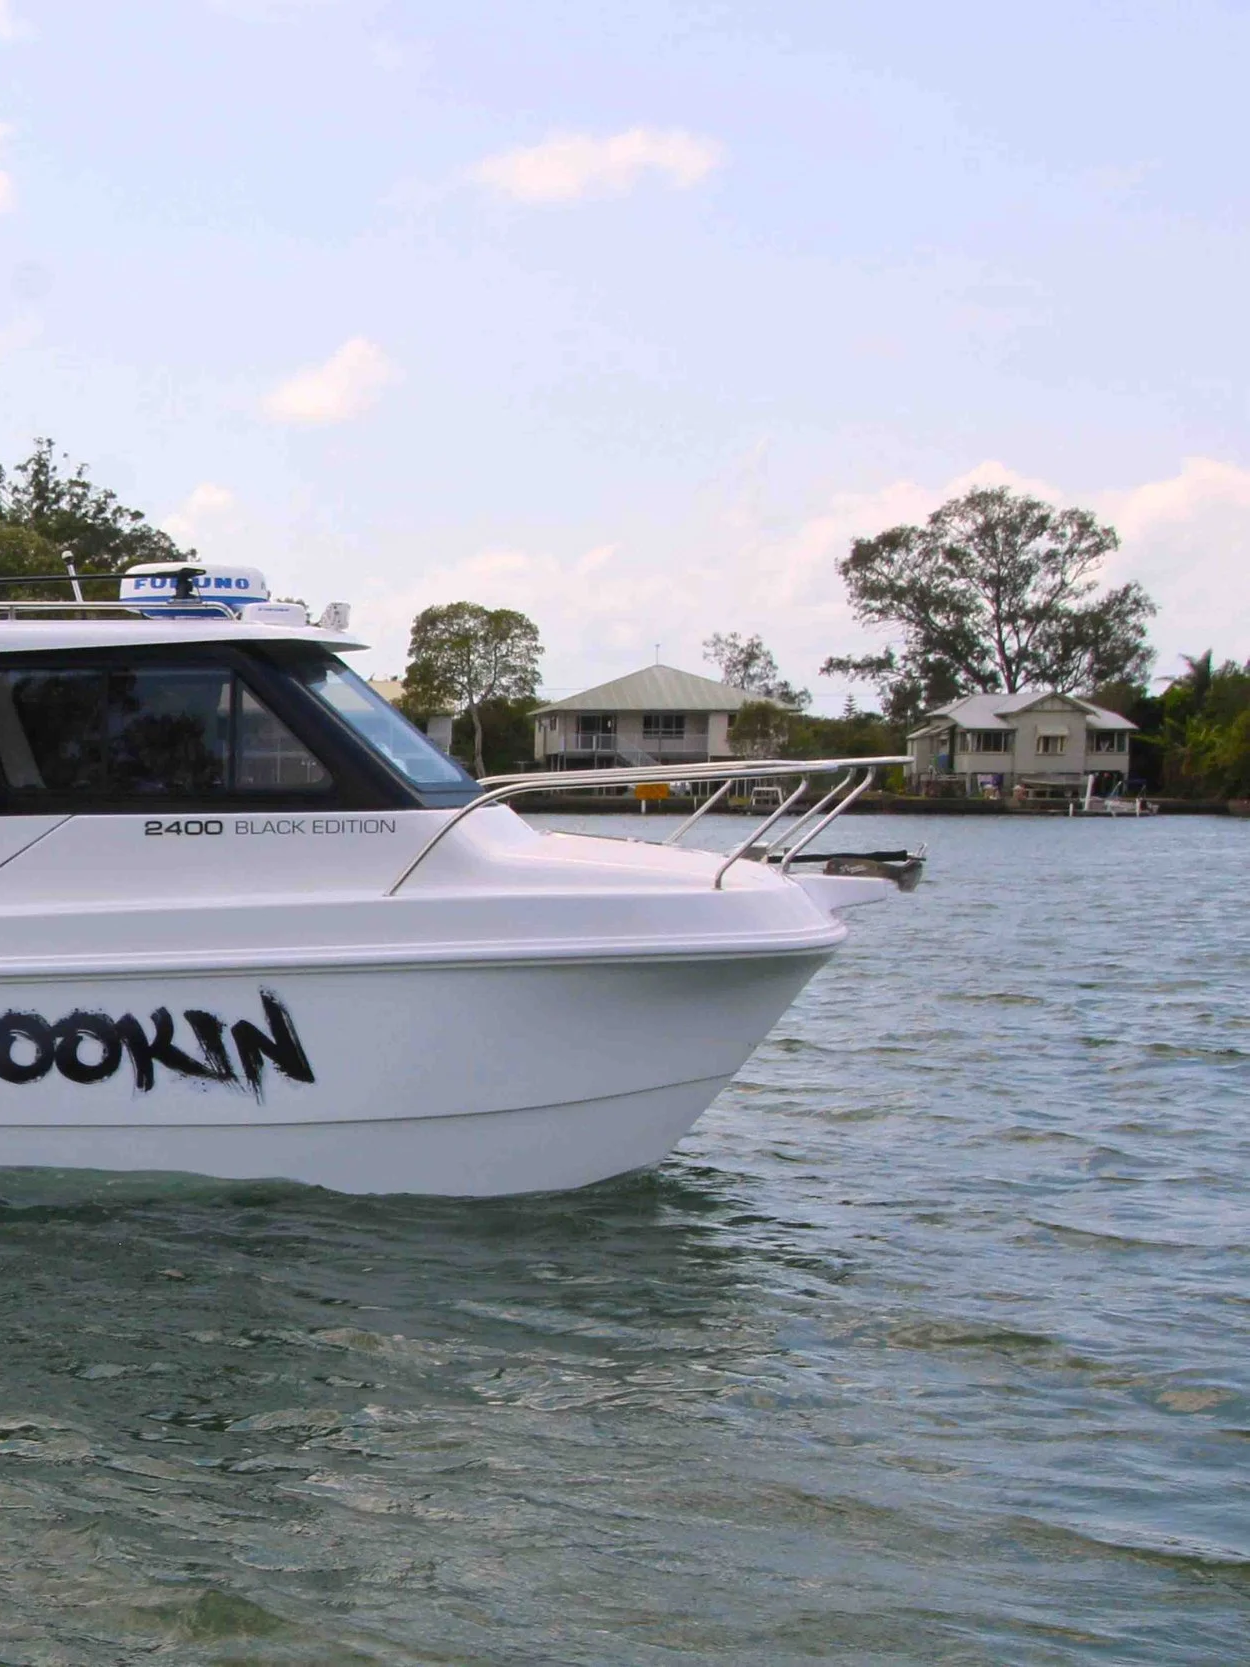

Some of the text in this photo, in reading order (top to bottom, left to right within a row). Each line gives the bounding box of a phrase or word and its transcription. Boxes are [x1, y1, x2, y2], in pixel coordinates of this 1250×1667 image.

[144, 819, 396, 836] 2400 BLACK EDITION
